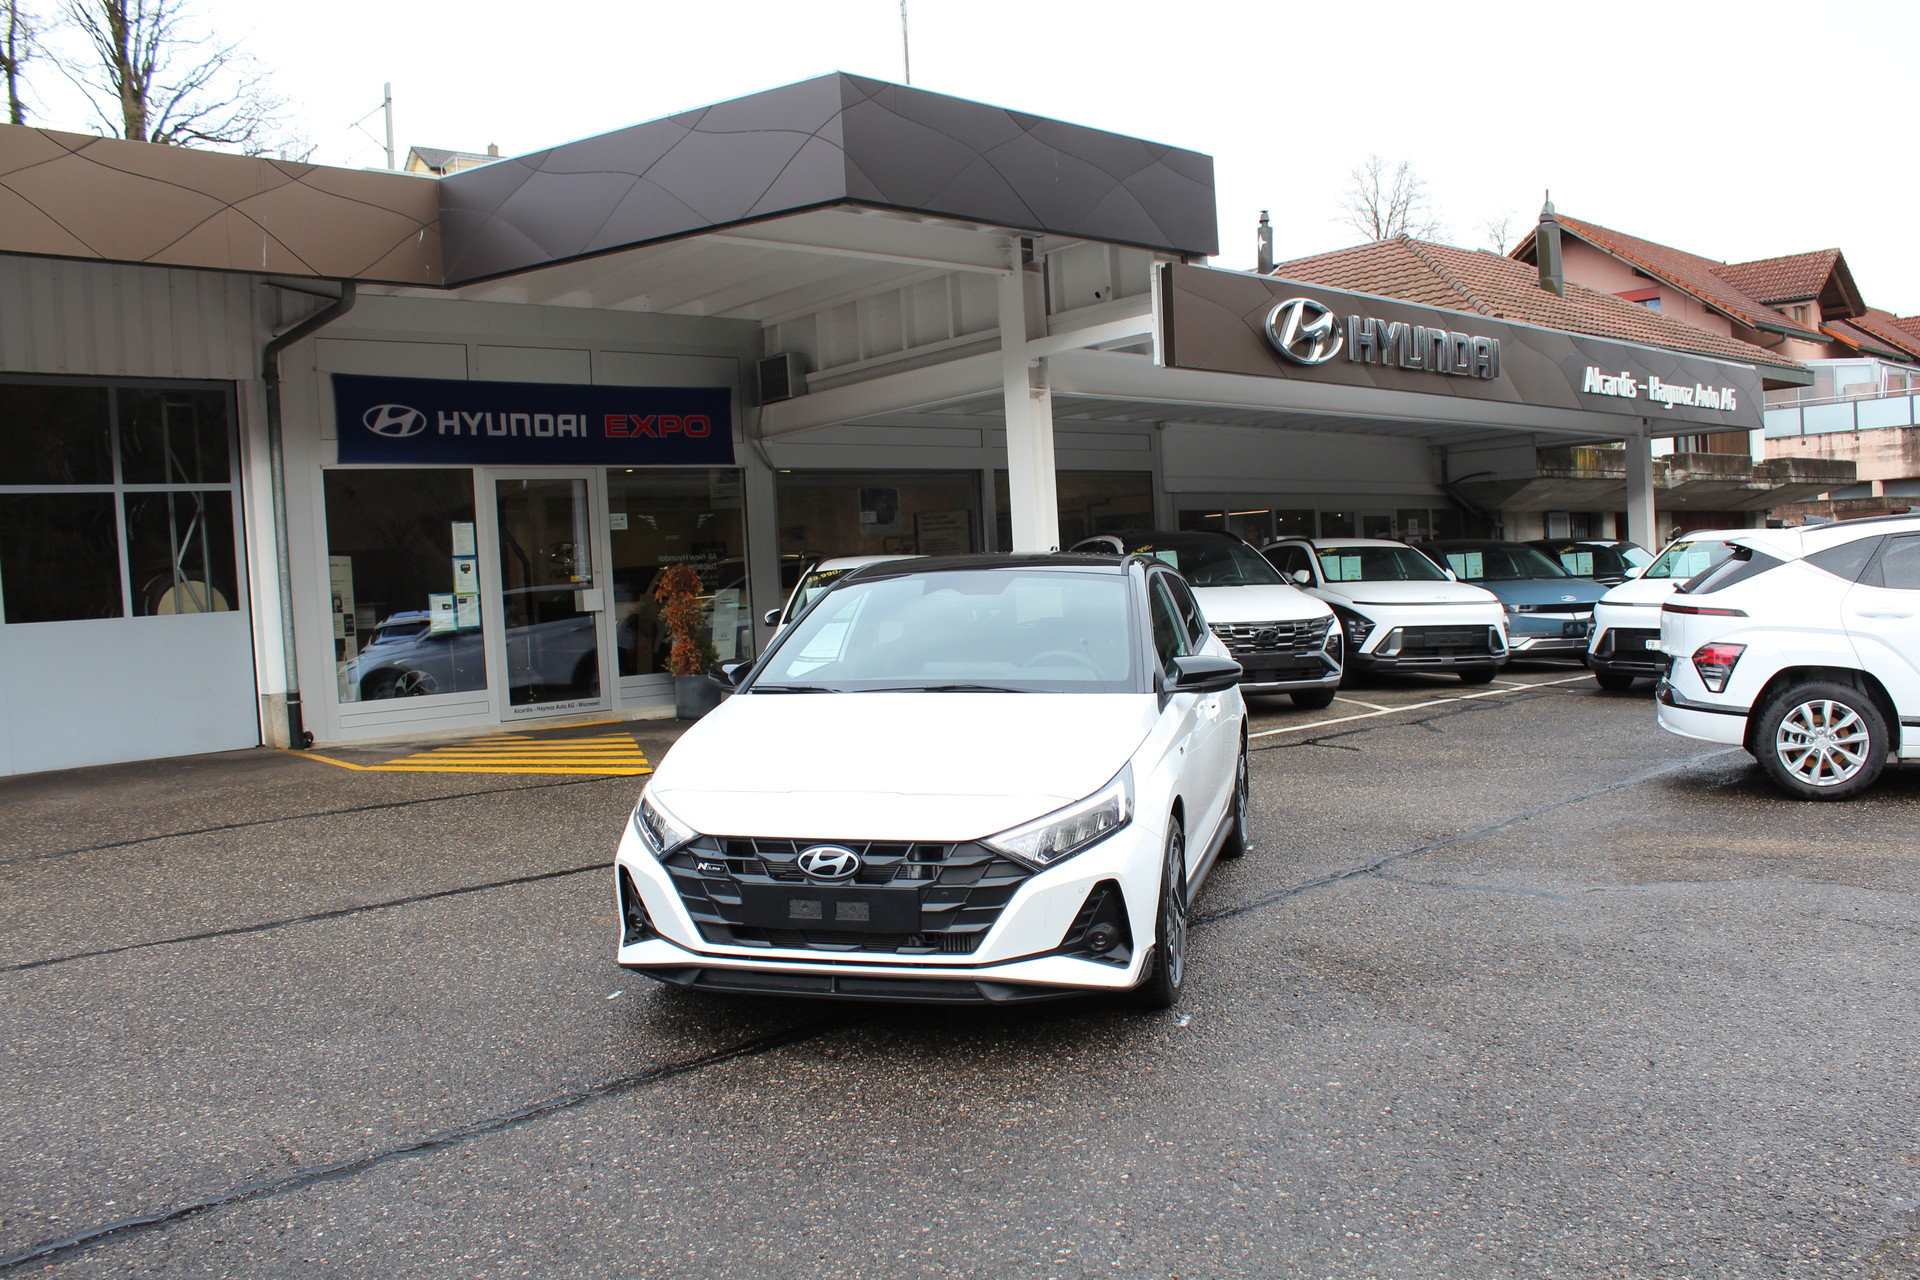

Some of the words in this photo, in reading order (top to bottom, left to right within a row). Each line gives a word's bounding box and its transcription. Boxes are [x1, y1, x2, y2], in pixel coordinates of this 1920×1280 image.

[1347, 314, 1501, 379] HYUNDAI
[1583, 366, 1637, 399] Alcardis
[1648, 375, 1695, 410] Haymoz
[1694, 382, 1720, 410] Auto
[1719, 386, 1737, 412] AG
[437, 410, 588, 438] HYUNDAI
[603, 413, 711, 438] EXPO
